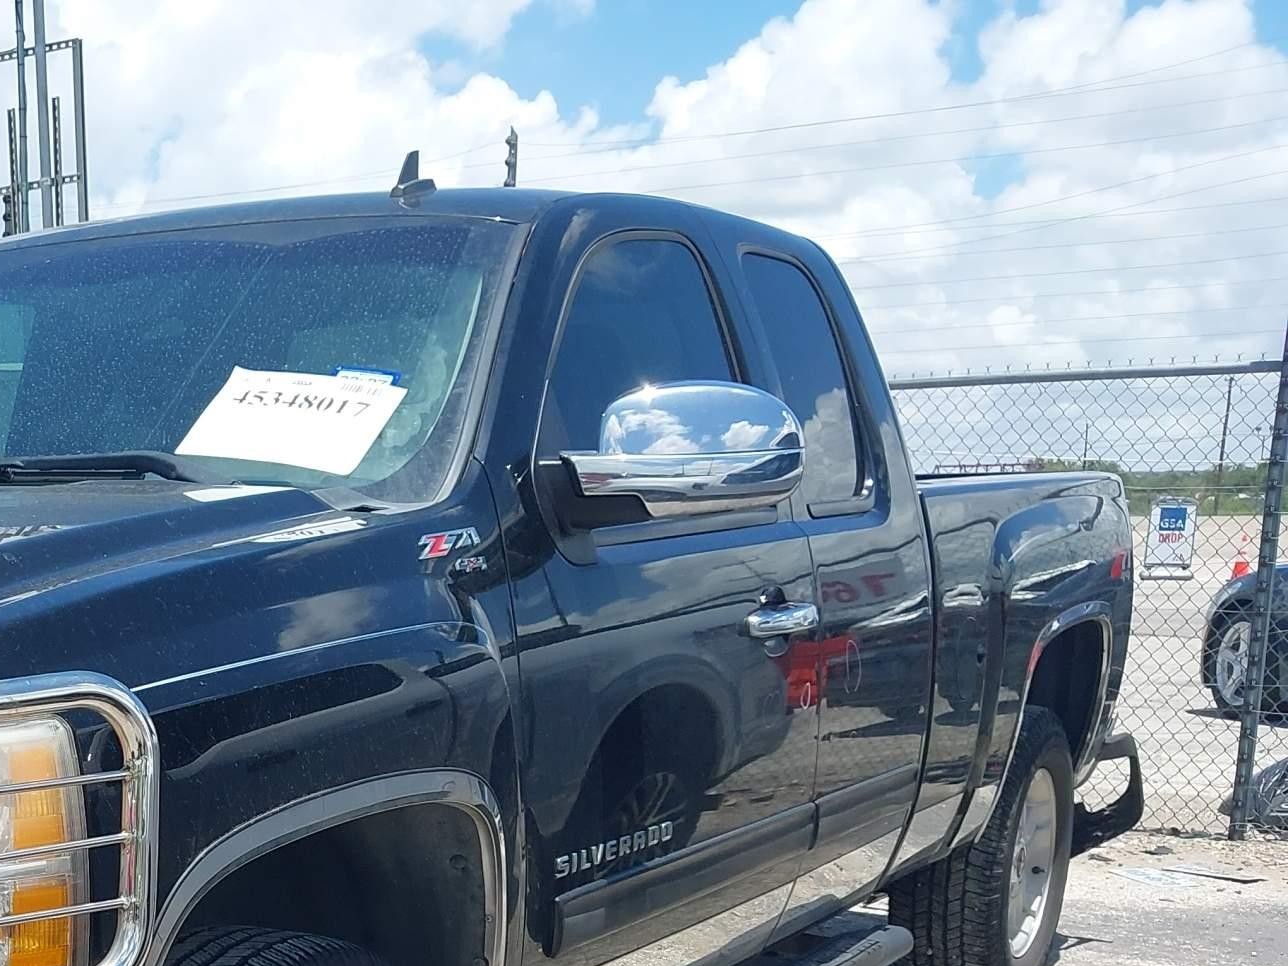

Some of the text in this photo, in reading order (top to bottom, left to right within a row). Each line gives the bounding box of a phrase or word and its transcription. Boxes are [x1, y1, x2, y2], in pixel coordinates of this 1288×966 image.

[232, 389, 371, 417] 45348017
[1160, 519, 1184, 528] GSA
[417, 526, 481, 560] Z71
[1158, 533, 1183, 543] DROP
[554, 820, 673, 879] SILVERADO
